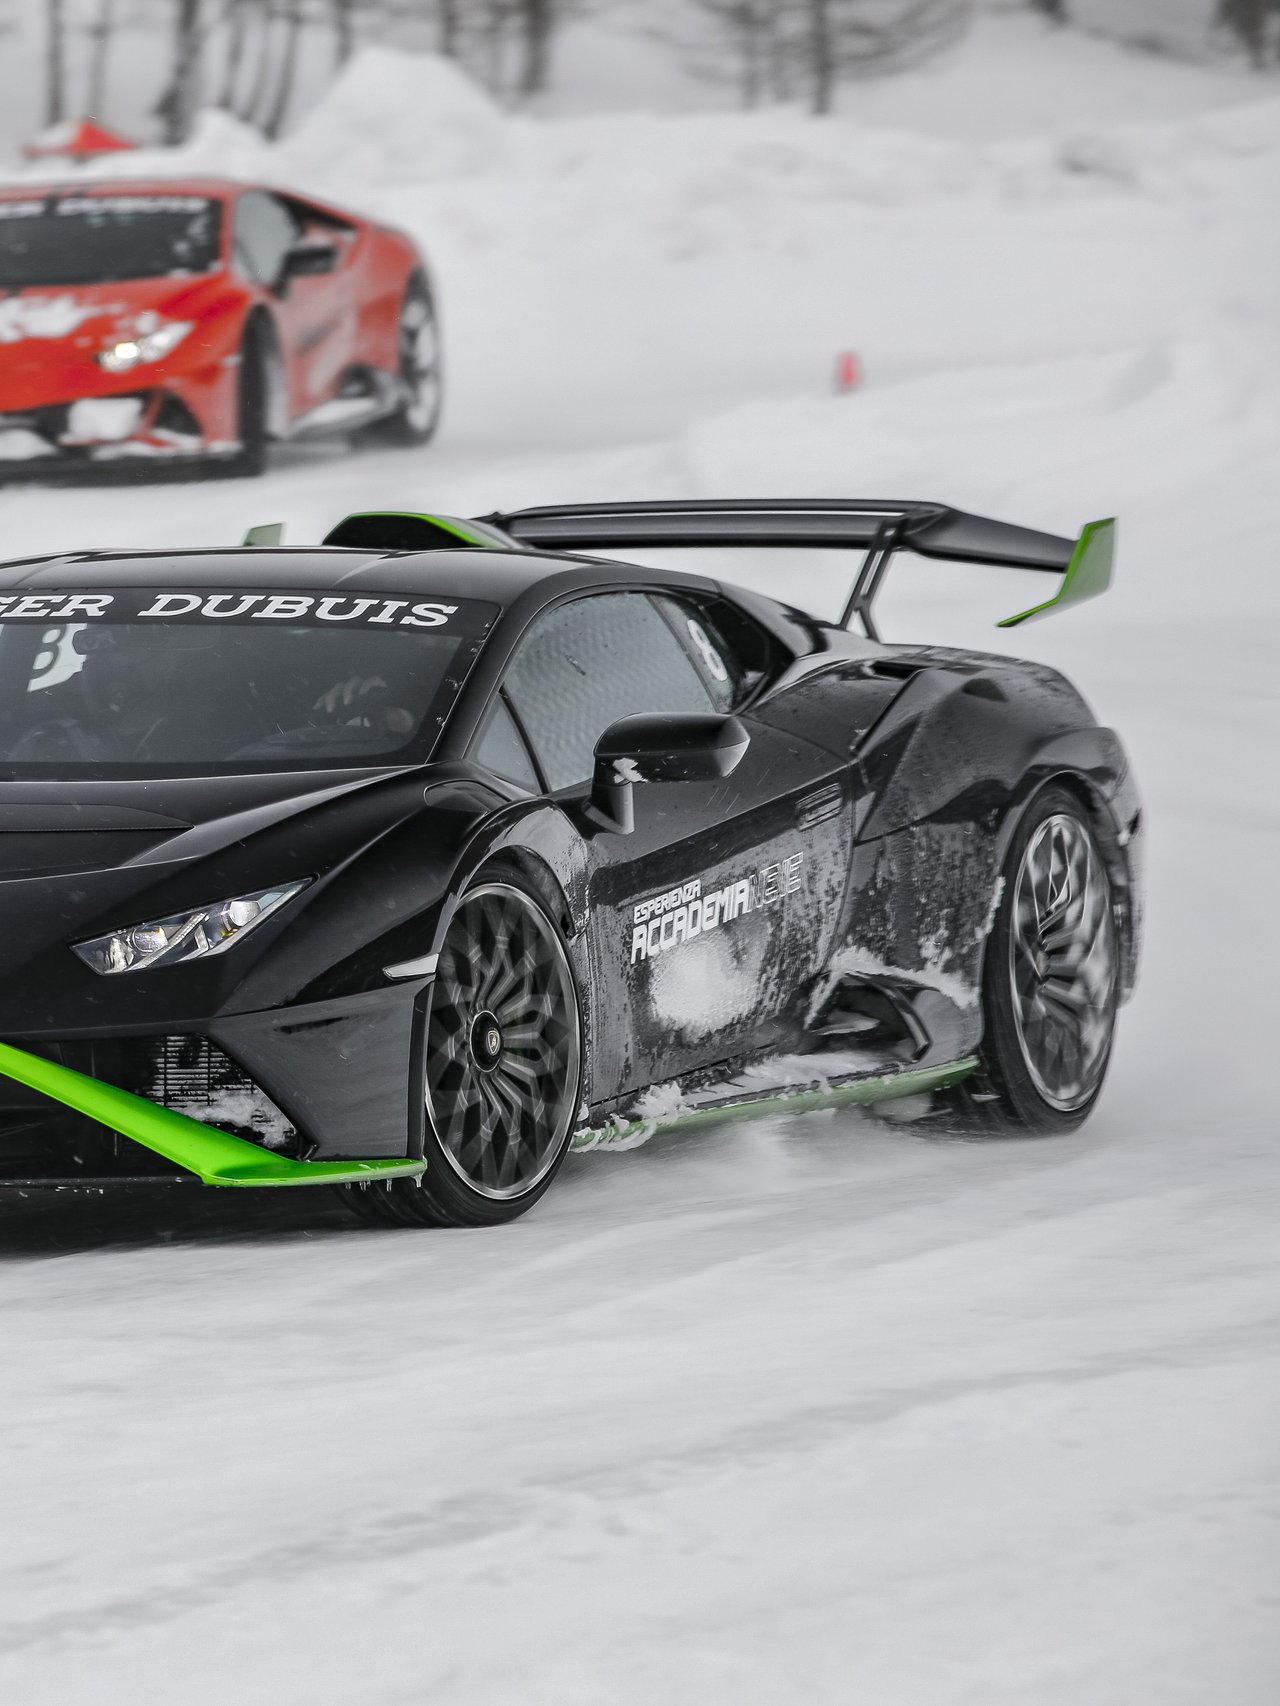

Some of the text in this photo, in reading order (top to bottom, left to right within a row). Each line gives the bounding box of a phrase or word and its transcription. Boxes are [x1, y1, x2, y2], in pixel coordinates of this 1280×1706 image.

[138, 593, 459, 627] DUBUIS
[687, 619, 727, 681] 8
[633, 879, 701, 924] ESPERIENZA
